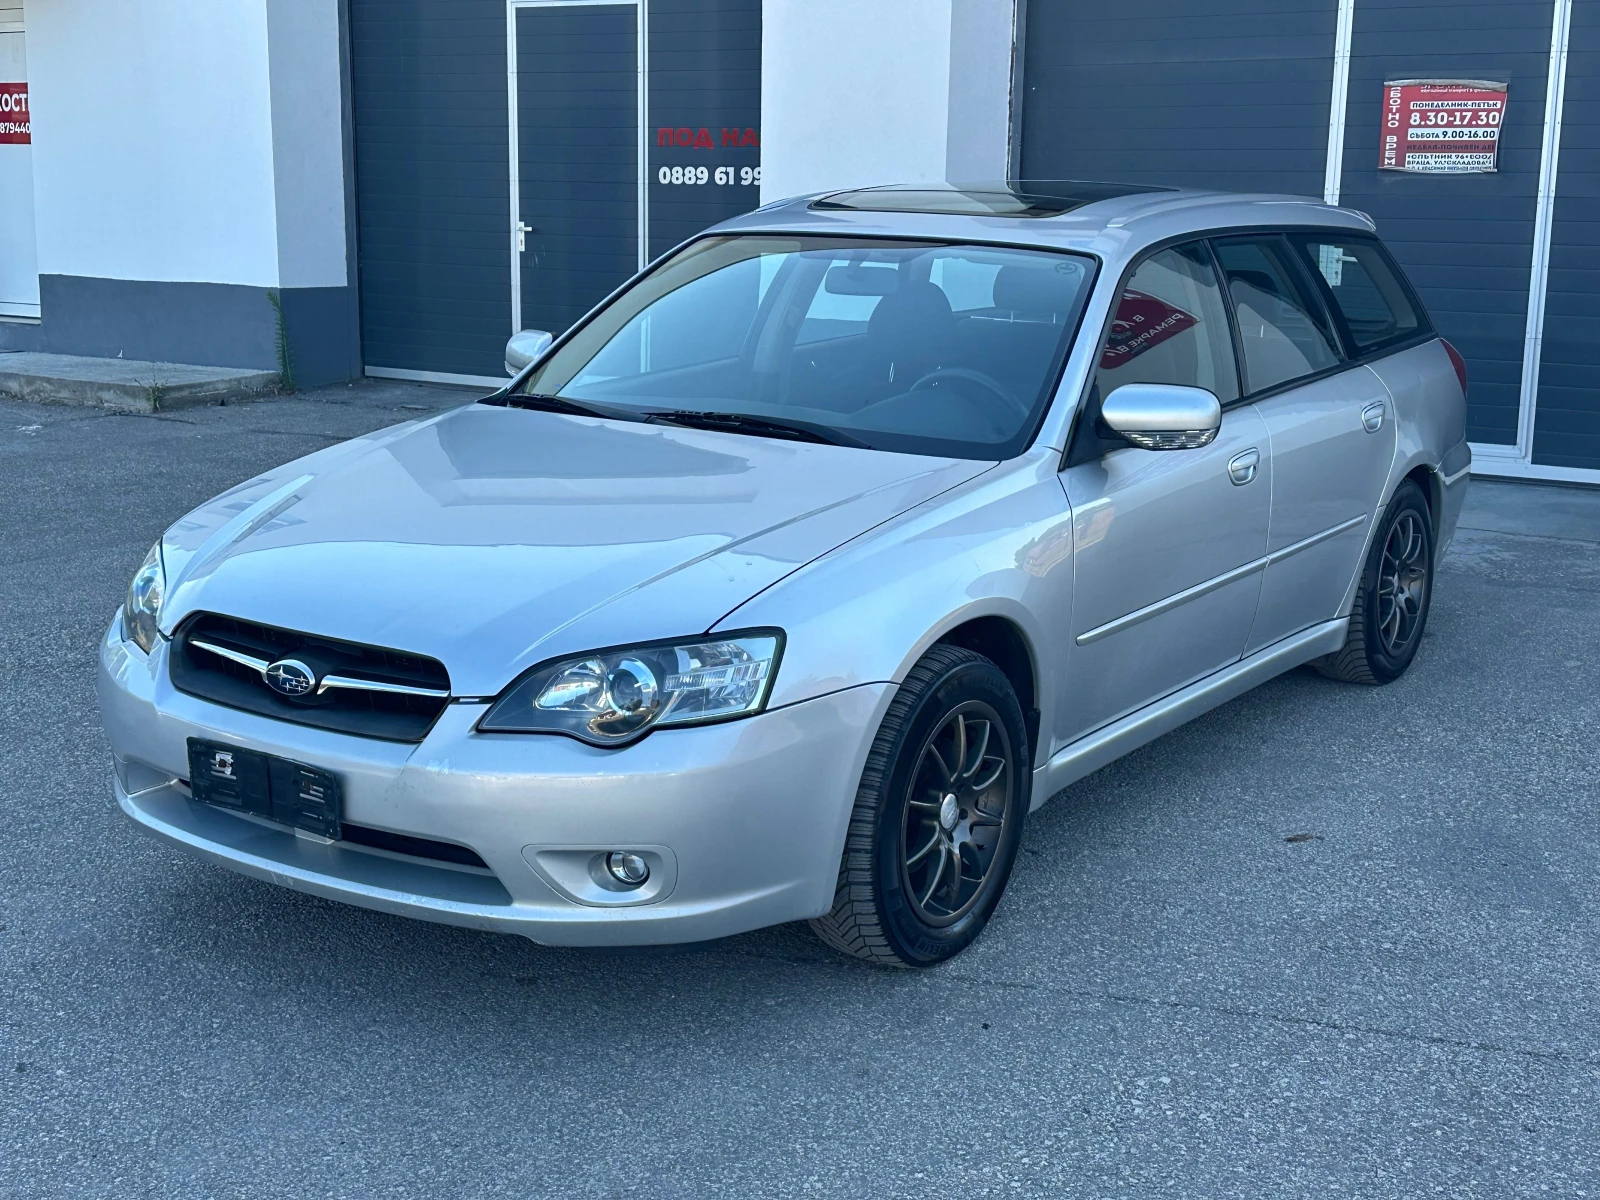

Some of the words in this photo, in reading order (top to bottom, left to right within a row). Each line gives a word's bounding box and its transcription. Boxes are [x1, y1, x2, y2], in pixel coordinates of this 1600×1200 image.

[1412, 101, 1498, 109] ПОНЕДЕЛНИК-ПЕТЪК
[1410, 112, 1500, 125] 8.30-17.30
[657, 127, 715, 150] ПОД
[721, 127, 760, 147] НА
[1441, 130, 1496, 139] 9.00-16.00
[1384, 135, 1398, 168] ВРЕМ
[658, 166, 709, 185] 0889
[714, 166, 735, 186] 61
[740, 166, 761, 186] 99
